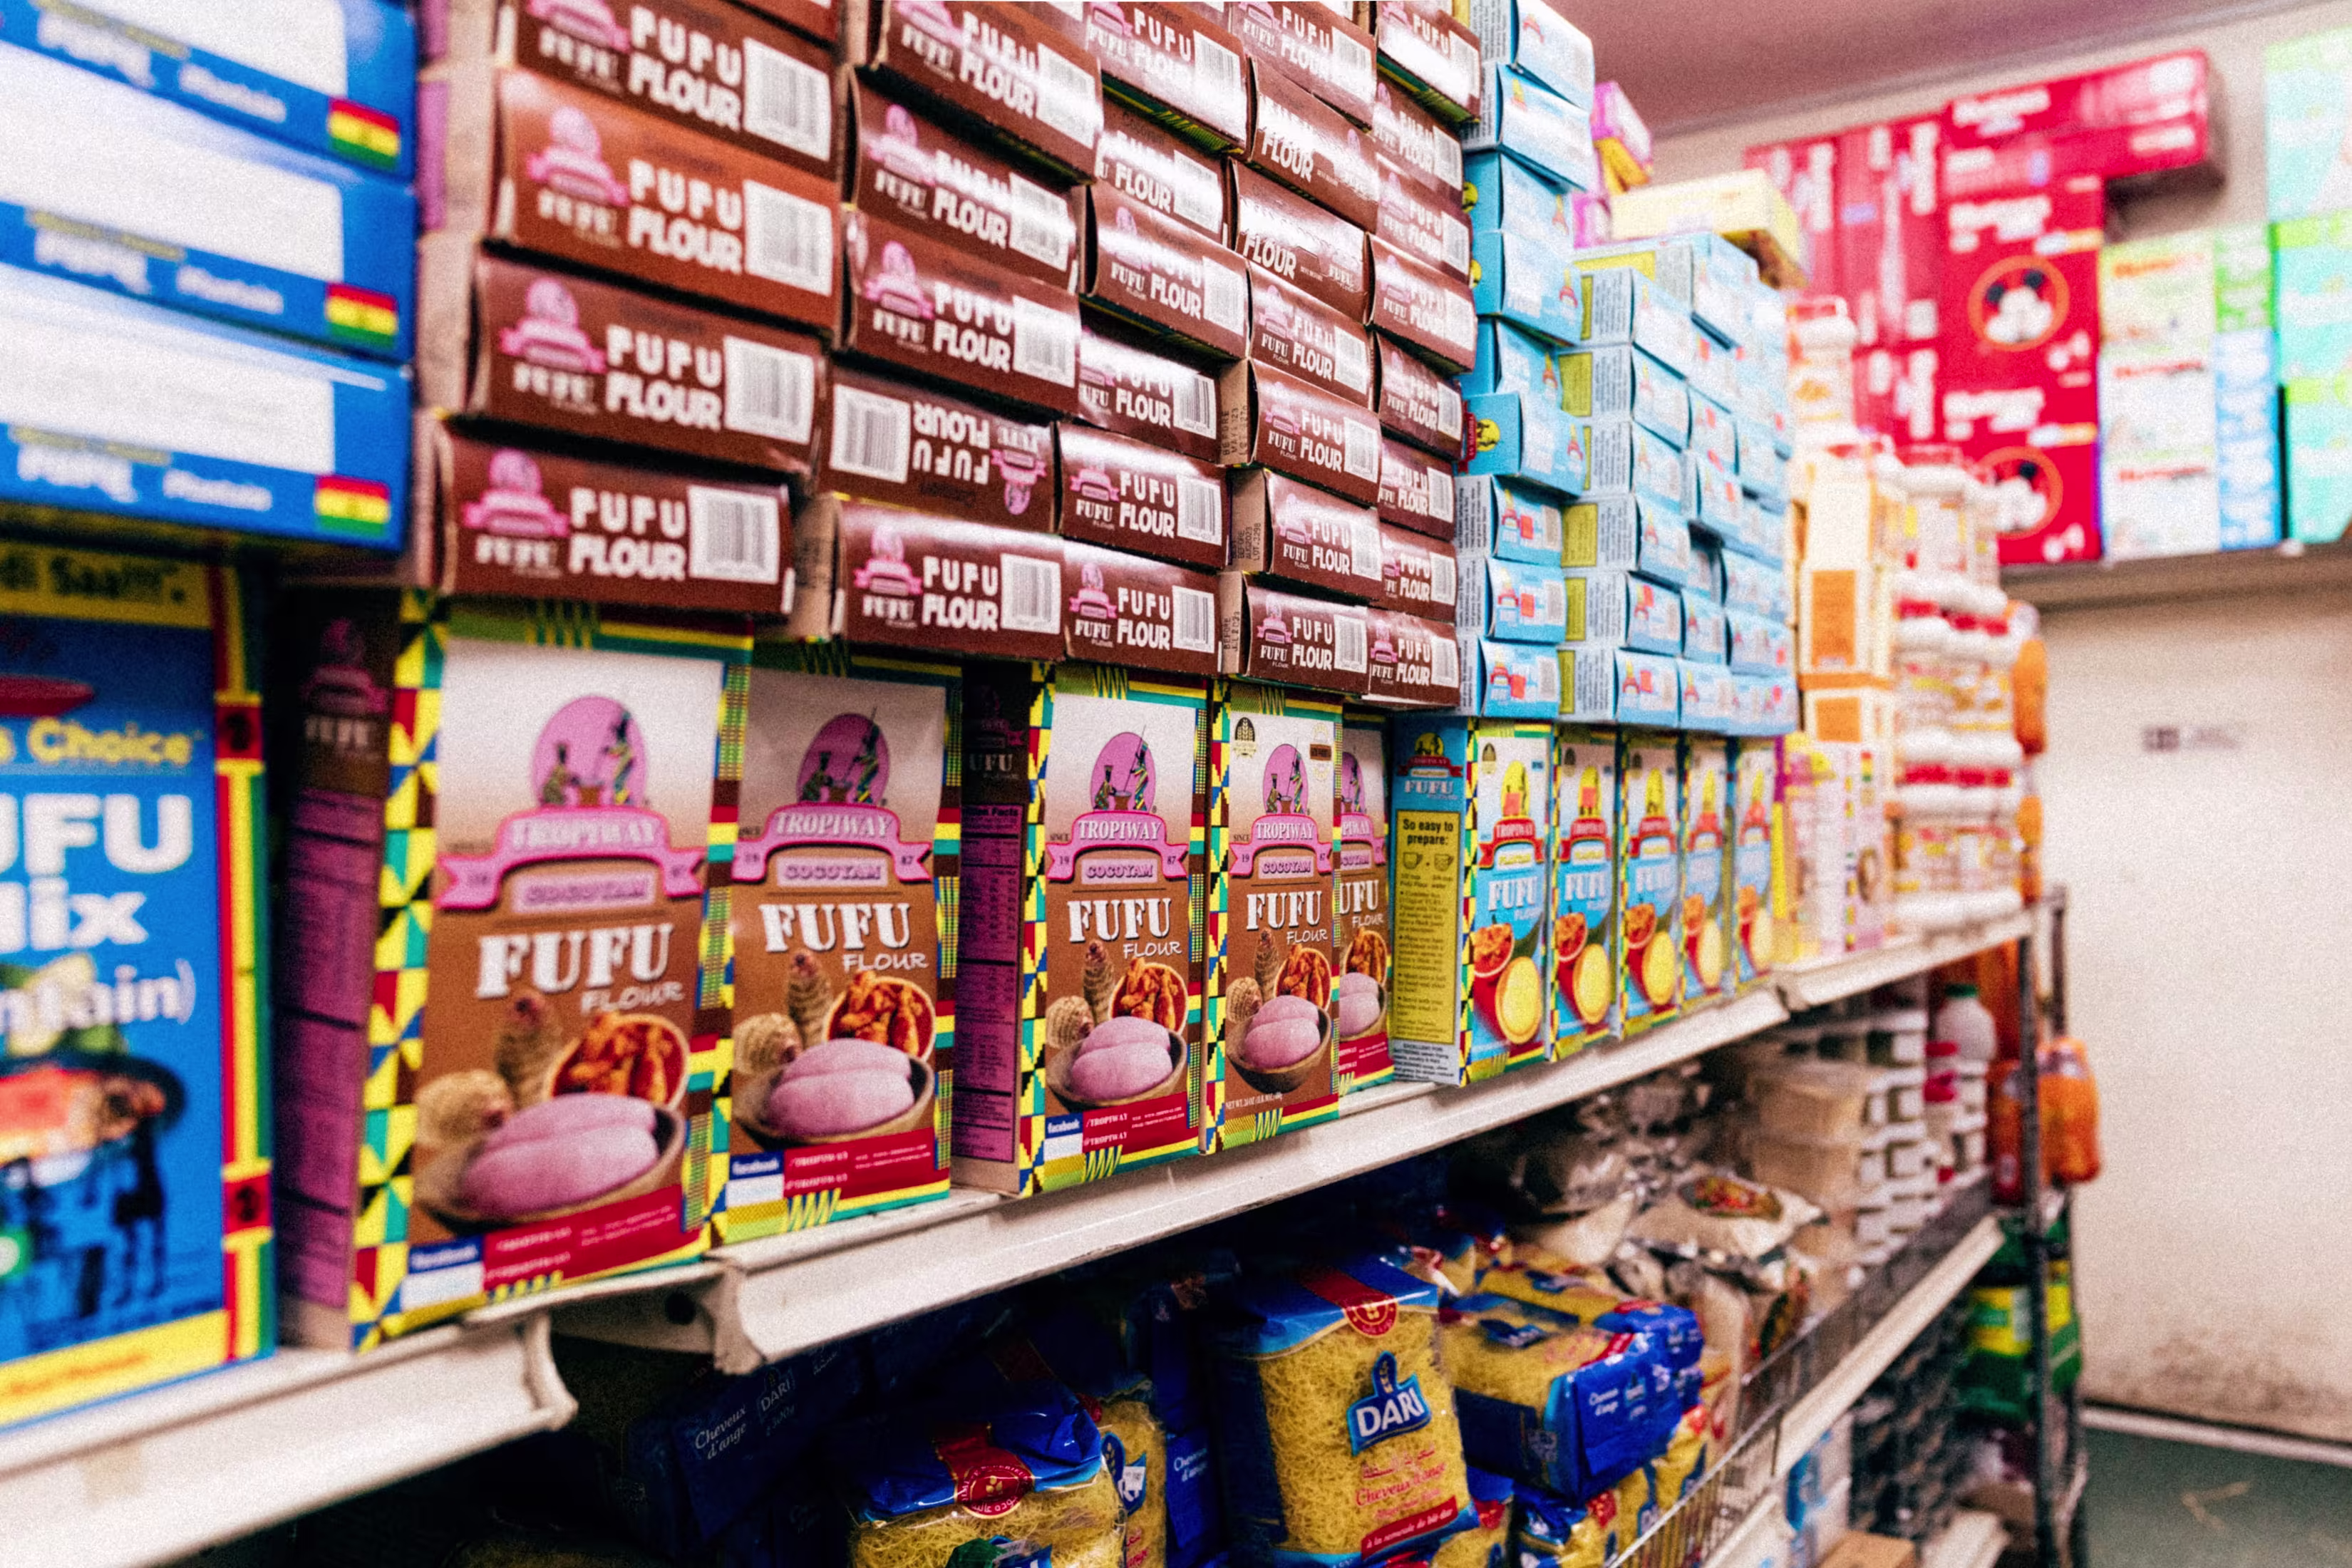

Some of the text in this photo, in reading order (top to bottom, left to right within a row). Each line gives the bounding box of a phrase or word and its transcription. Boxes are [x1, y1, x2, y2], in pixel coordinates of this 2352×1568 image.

[1134, 9, 1192, 62] FUFU
[1243, 18, 1275, 46] FUFU
[1282, 7, 1330, 51] FUFU
[1413, 16, 1450, 53] FUFU
[960, 50, 1037, 118] FLOUR
[1260, 128, 1314, 182] FLOUR
[1115, 163, 1171, 212] FLOUR
[934, 187, 1009, 249] FLOUR
[1242, 234, 1297, 279] FLOUR
[1111, 262, 1145, 291] FUFU
[1150, 274, 1203, 319] FLOUR
[932, 321, 1011, 373] FLOUR
[1262, 333, 1289, 360] FUFU
[1293, 341, 1333, 380] FLOUR
[1115, 387, 1171, 428] FLOUR
[1409, 404, 1437, 430] FLOUR
[914, 401, 991, 449] FLOUR
[1301, 408, 1342, 445] FUFU
[1268, 432, 1296, 453] FUFU
[912, 440, 990, 485] FUFU
[1299, 443, 1343, 472] FLOUR
[1119, 470, 1174, 507] FUFU
[1076, 500, 1113, 522] FUFU
[1398, 495, 1428, 515] FLOUR
[1119, 502, 1174, 538] FLOUR
[1312, 519, 1350, 549] FUFU
[1283, 544, 1309, 564] FUFU
[1312, 546, 1351, 575] FLOUR
[923, 556, 998, 595] FUFU
[1399, 577, 1430, 602] FLOUR
[922, 596, 998, 630] FLOUR
[1117, 587, 1169, 620] FUFU
[1074, 619, 1110, 639] FUFU
[1116, 619, 1170, 650] FLOUR
[1292, 617, 1333, 641] FUFU
[1260, 645, 1287, 661] FUFU
[1292, 645, 1332, 670] FLOUR
[1399, 636, 1430, 661] FUFU
[1373, 664, 1393, 679] FUFU
[1398, 661, 1430, 686] FLOUR
[1404, 780, 1453, 795] FUFU
[775, 811, 892, 840] TROPIWAY
[1078, 818, 1163, 842] TROPIWAY
[1234, 834, 1250, 842] SINCE
[1257, 823, 1315, 841] TROPIWAY
[1403, 820, 1454, 833] So easy to
[1407, 834, 1449, 846] prepare:
[1059, 855, 1177, 866] 19 87
[1085, 862, 1155, 880] COCOYAM
[1242, 853, 1250, 863] 19
[1262, 862, 1312, 875] COCOYAM
[1340, 880, 1379, 917] UFU
[1488, 877, 1537, 912] FUFU
[1067, 897, 1172, 943] FUFU
[1247, 890, 1324, 930] FUFU
[1351, 914, 1384, 928] FLOUR
[758, 903, 910, 953] FUFU
[1286, 928, 1329, 945] FLOUR
[475, 922, 674, 999] FUFU
[1123, 941, 1183, 959] FLOUR
[842, 952, 929, 979] FLOUR
[580, 982, 686, 1013] FLOUR
[760, 1379, 791, 1412] DARI
[1357, 1387, 1425, 1438] DARI
[694, 1406, 747, 1450] Cheveux
[707, 1424, 747, 1460] d'ange
[1356, 1481, 1411, 1507] Cheveux
